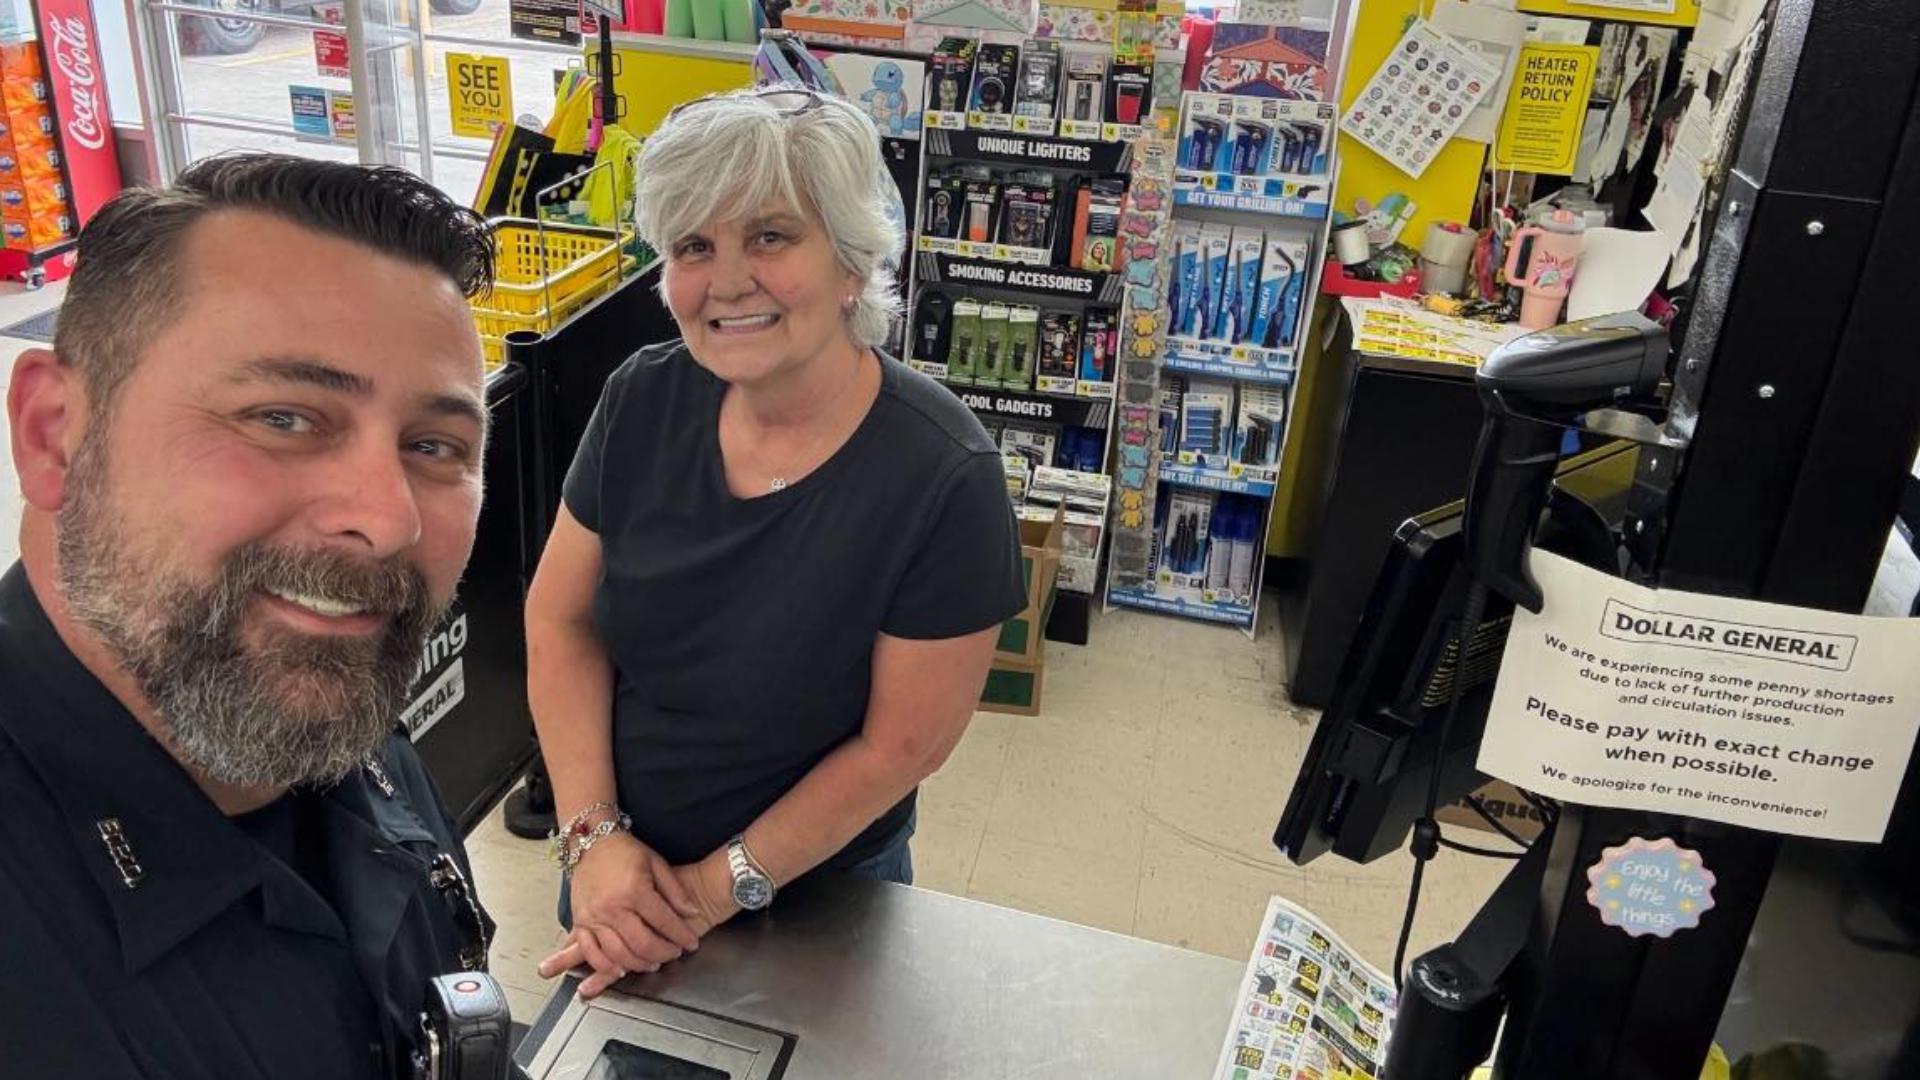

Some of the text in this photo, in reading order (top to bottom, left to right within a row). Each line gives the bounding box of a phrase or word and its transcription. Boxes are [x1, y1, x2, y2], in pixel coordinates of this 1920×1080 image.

[459, 63, 499, 91] SEE
[1524, 71, 1576, 87] RETURN
[1527, 56, 1579, 73] HEATER
[460, 89, 501, 108] YOU
[1521, 86, 1573, 103] POLICY
[977, 136, 1092, 162] UNIQUE LIGHTERS
[1187, 191, 1205, 206] GET
[1208, 193, 1235, 209] YOUR
[949, 263, 1093, 293] SMOKING ACCESSORIES
[1259, 287, 1271, 319] TORCH
[962, 394, 1053, 418] COOL GADGETS
[423, 613, 467, 673] ing
[1615, 612, 1840, 660] DOLLAR GENERAL
[1544, 633, 1895, 705] We are experiencing some penny shortages
[1579, 667, 1844, 717] due to lack of further production
[1618, 694, 1795, 727] and circulation issues.
[1526, 696, 1874, 771] Please pay with exact change
[1605, 746, 1778, 782] when possible.
[1542, 764, 1828, 819] We apologize for the inconvenience!
[1621, 860, 1703, 896] Enjoy the
[1627, 882, 1666, 906] little
[1623, 906, 1676, 928] things
